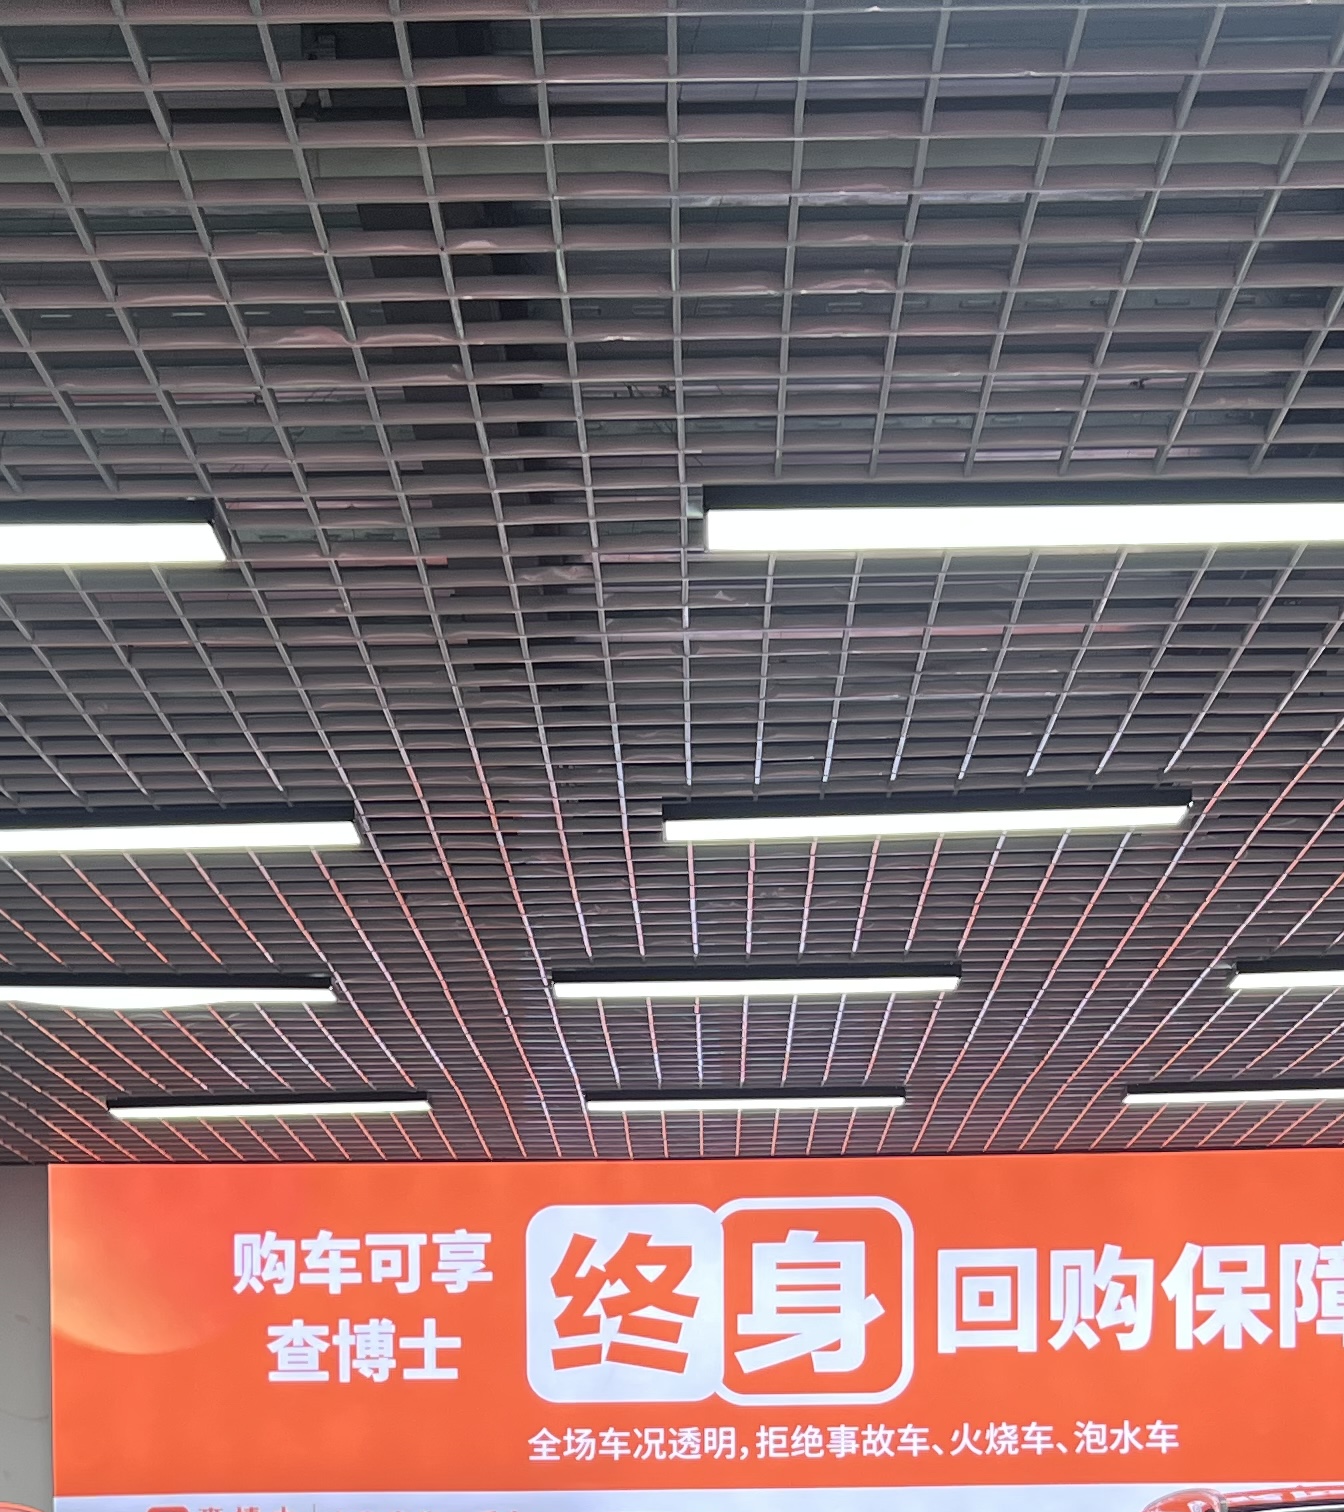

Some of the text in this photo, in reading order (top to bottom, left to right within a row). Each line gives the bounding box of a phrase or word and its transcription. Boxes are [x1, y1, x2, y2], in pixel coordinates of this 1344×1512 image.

[232, 1229, 493, 1294] 购车可享
[267, 1317, 461, 1383] 查博士
